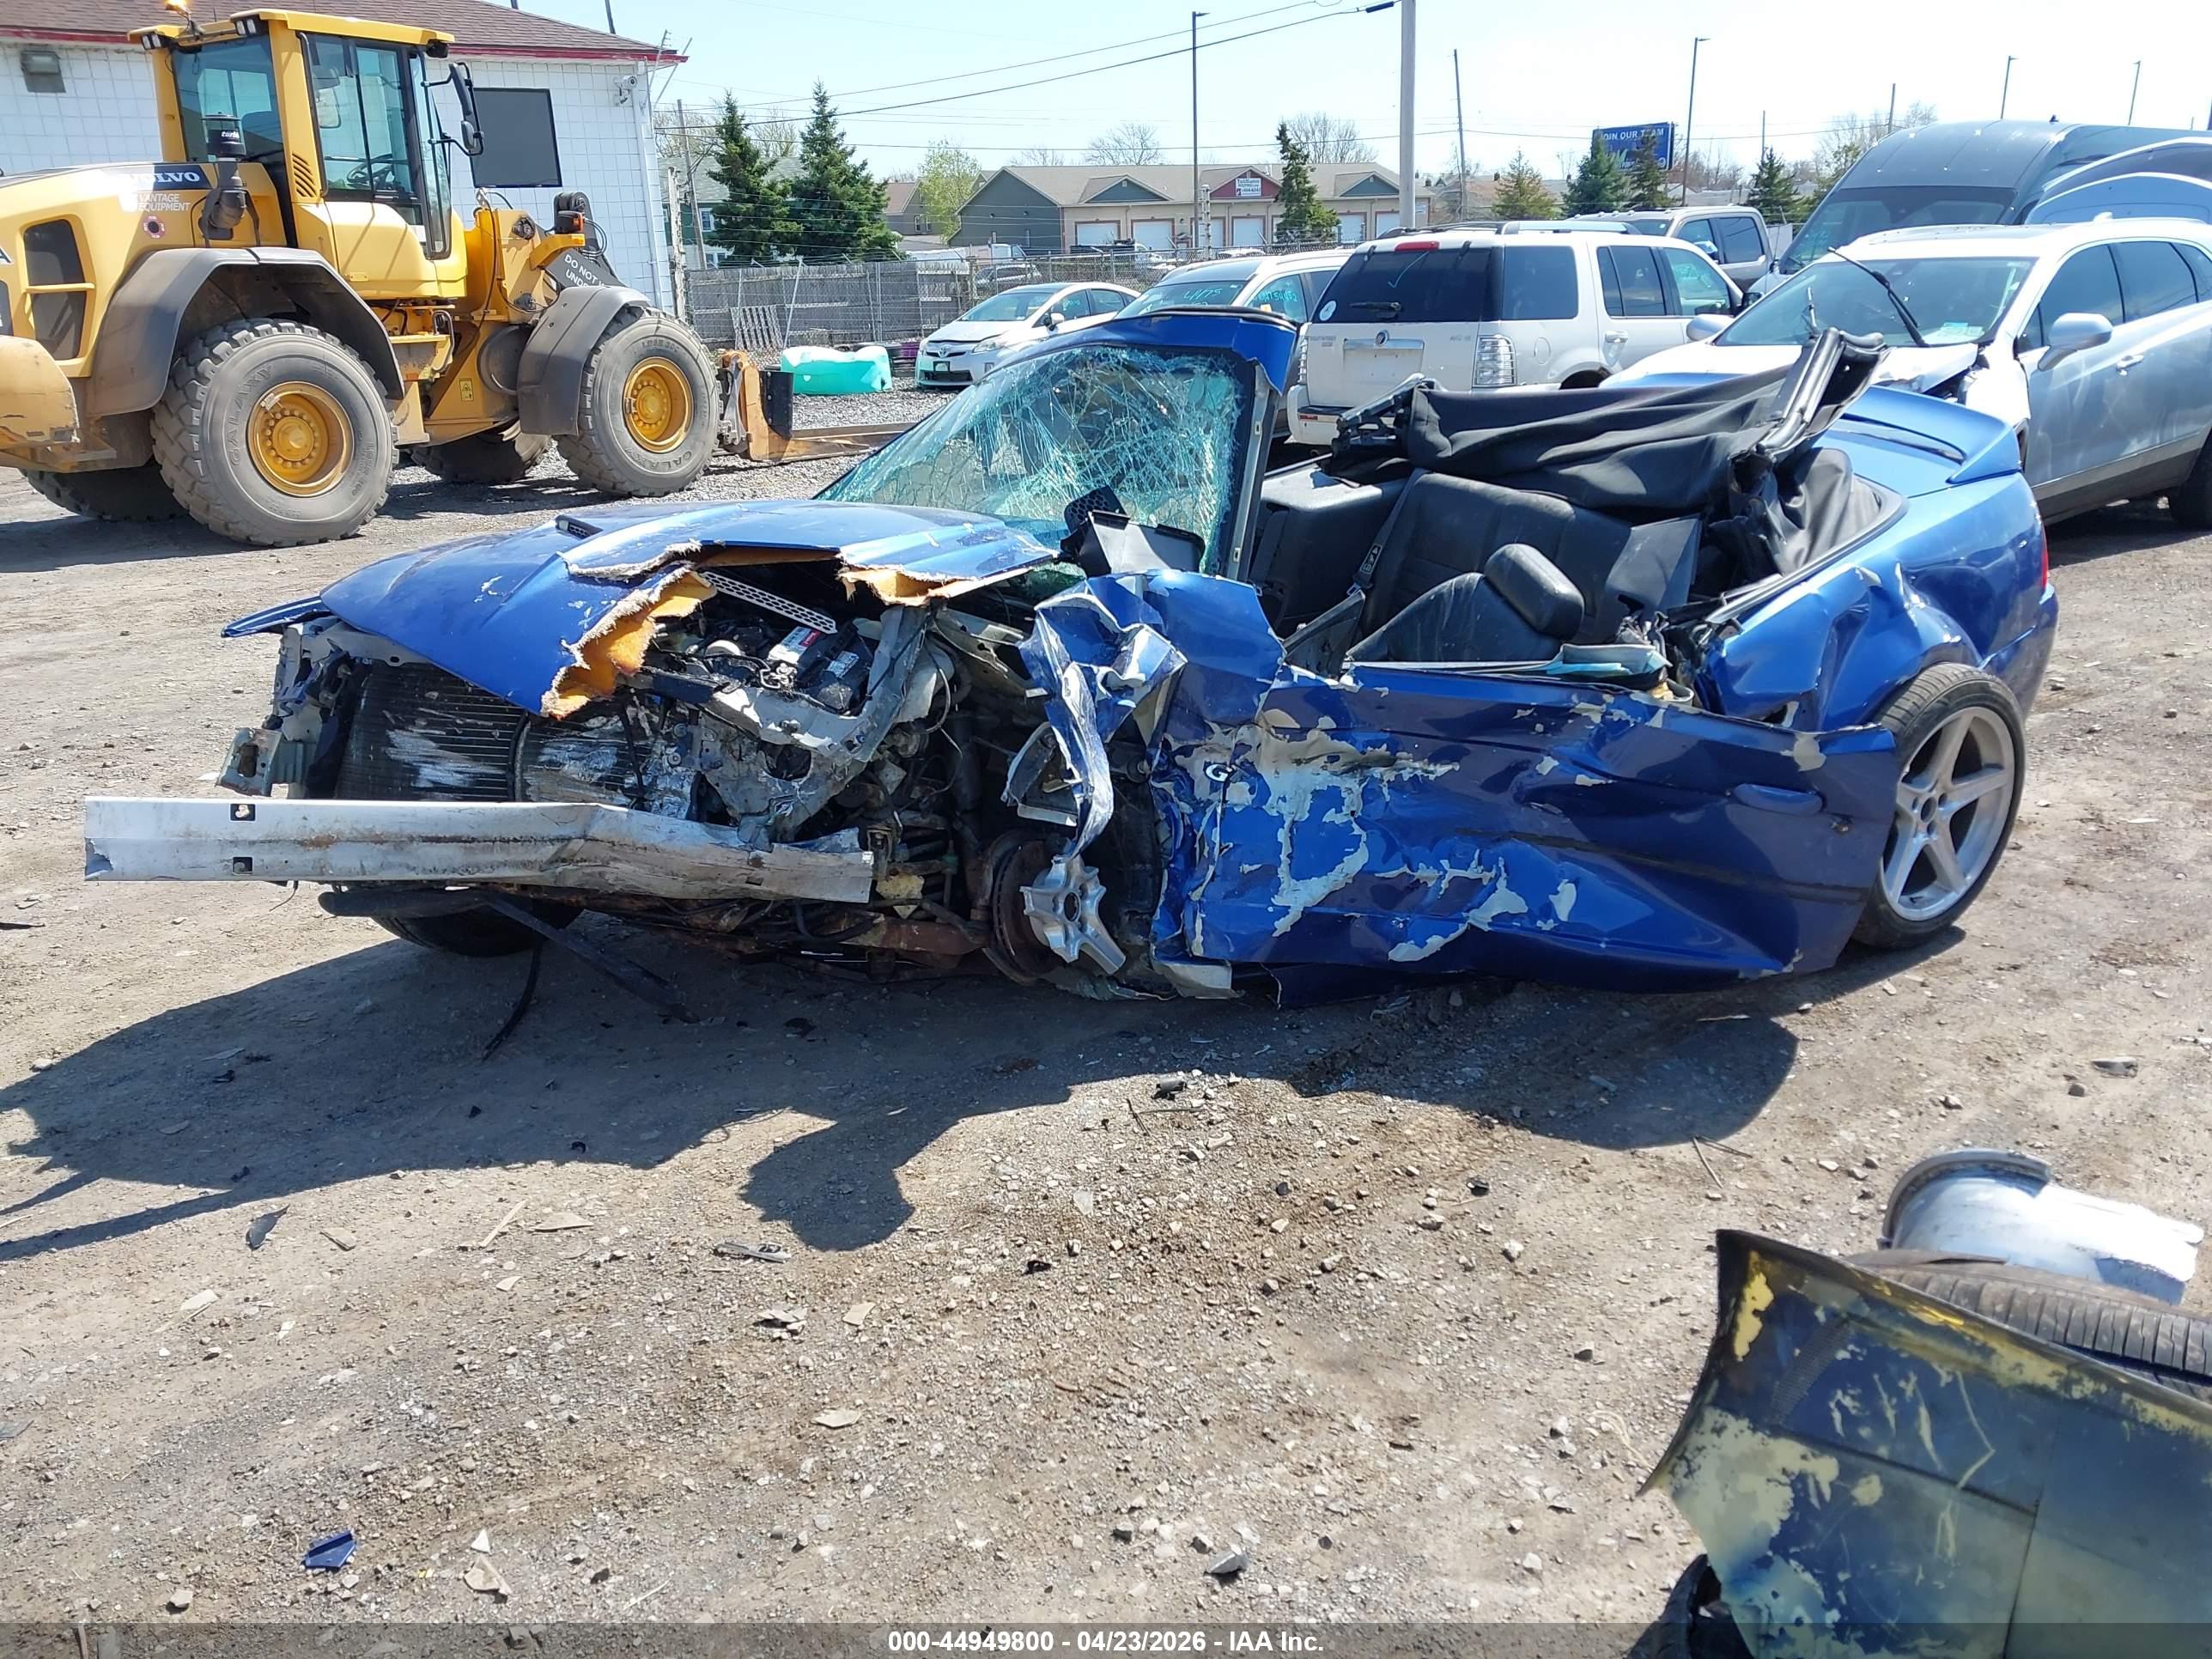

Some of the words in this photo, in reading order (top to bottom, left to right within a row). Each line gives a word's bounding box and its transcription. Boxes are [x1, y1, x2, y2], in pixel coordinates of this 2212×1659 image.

[221, 131, 240, 139] turb
[1620, 131, 1638, 139] OUR
[144, 171, 200, 183] LVO
[138, 193, 179, 203] VANTAGE
[138, 203, 191, 212] EQUIPMENT
[565, 253, 579, 269] DO
[578, 265, 599, 284] NOT
